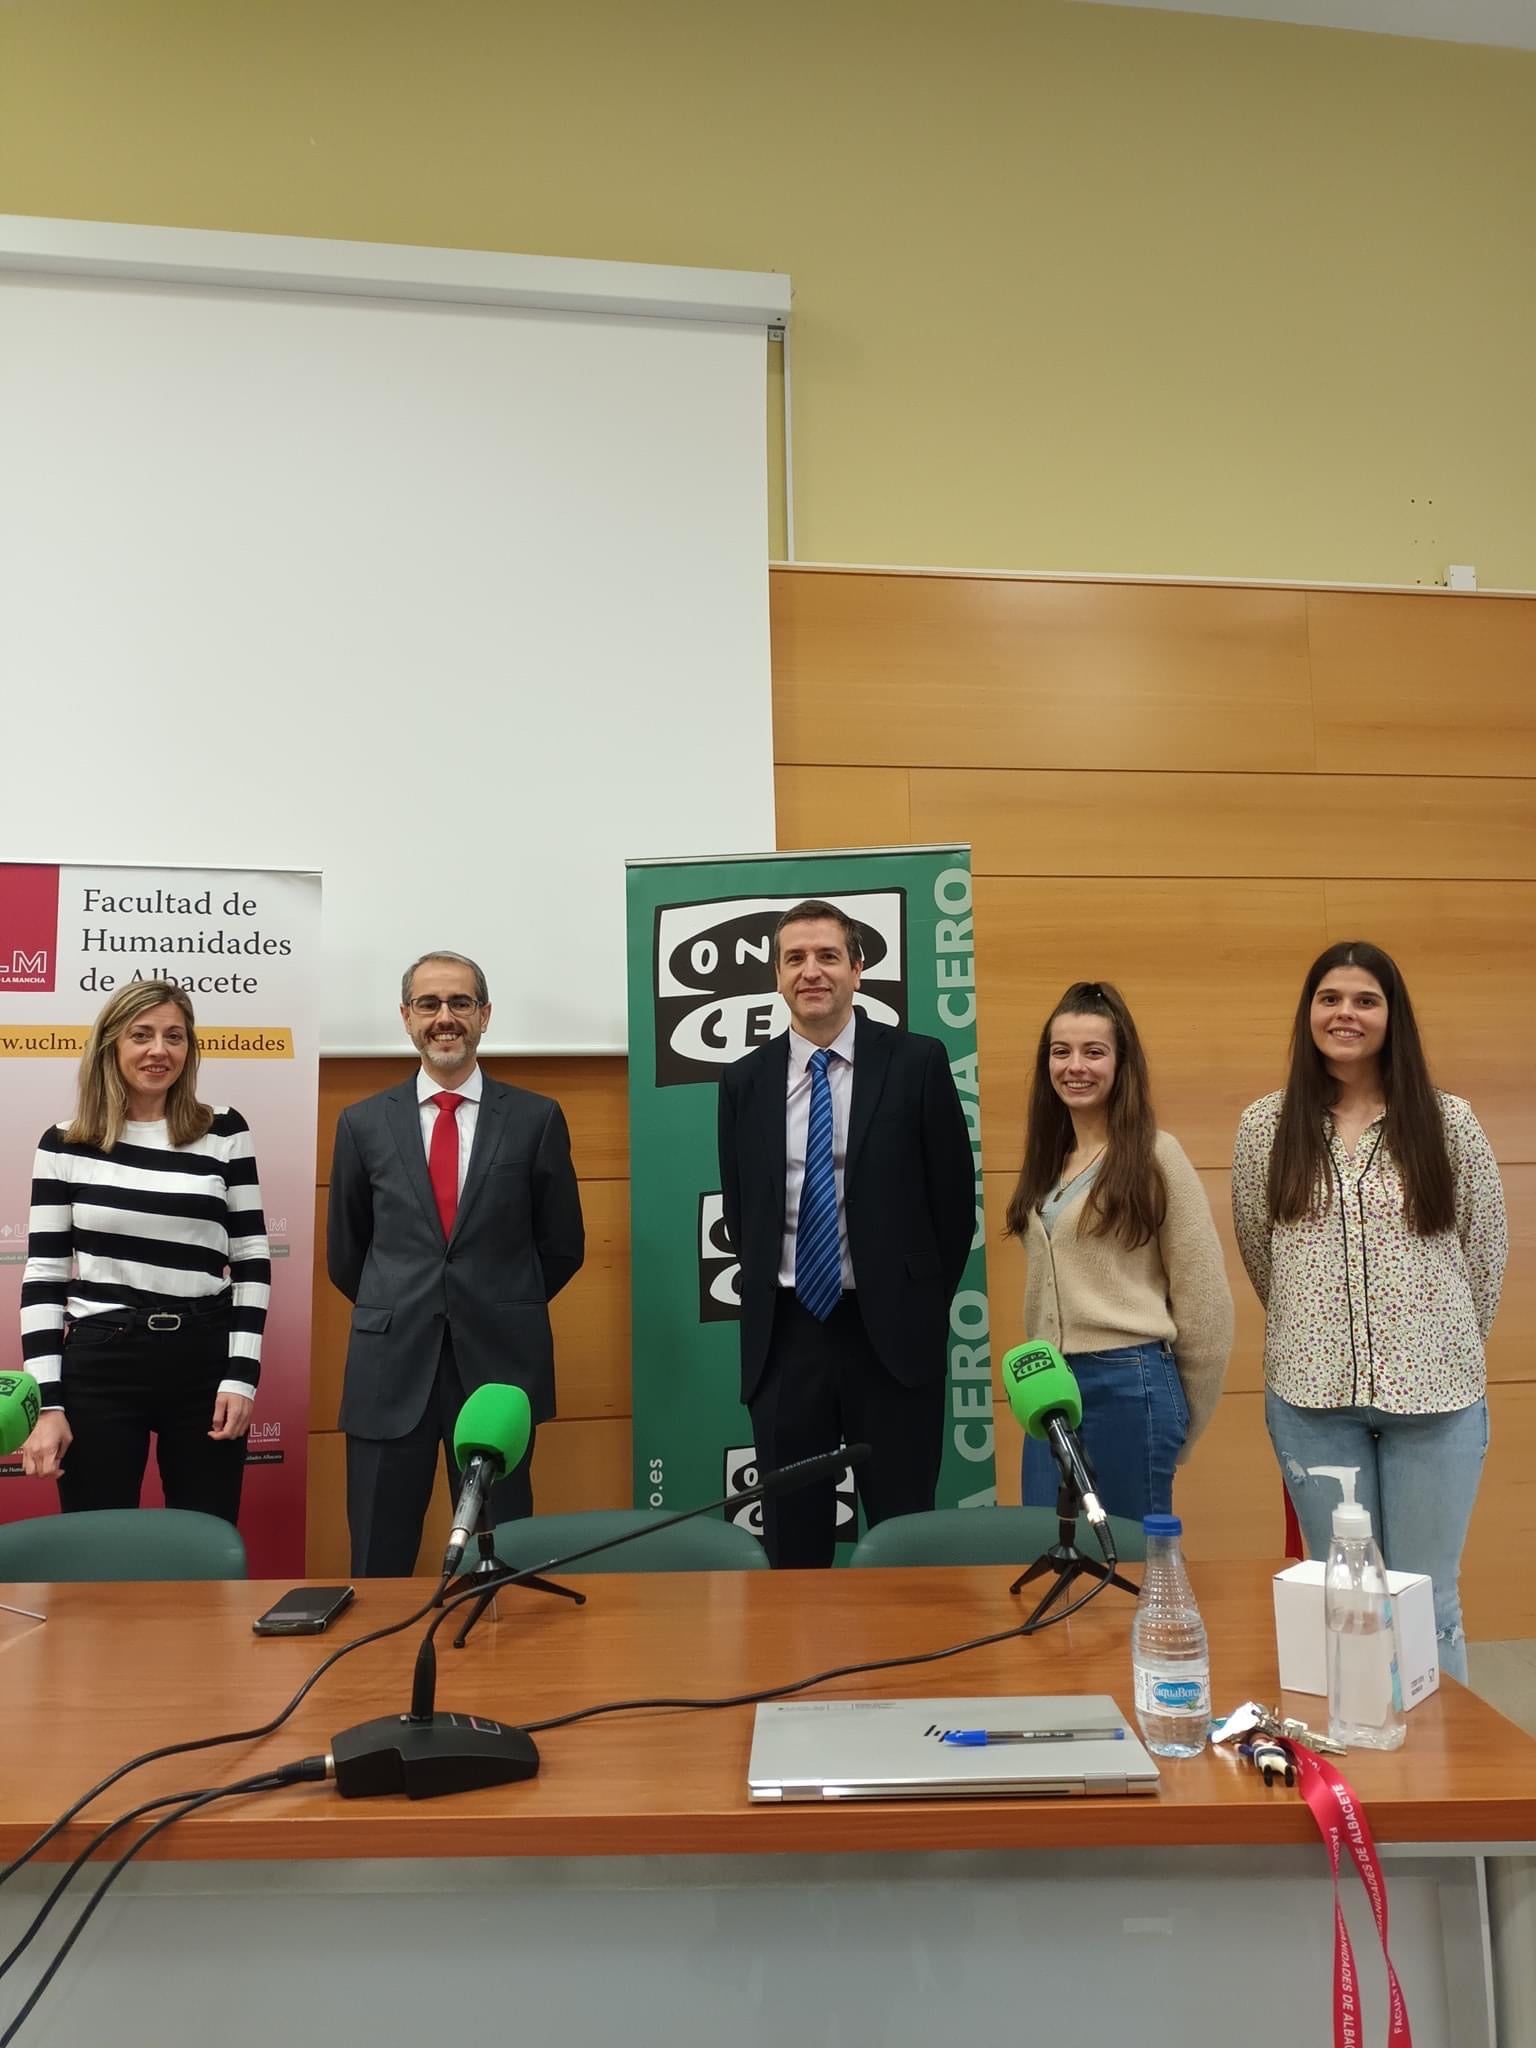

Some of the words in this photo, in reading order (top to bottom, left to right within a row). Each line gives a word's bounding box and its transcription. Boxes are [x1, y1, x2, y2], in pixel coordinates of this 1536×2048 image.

[82, 888, 213, 916] Facultad
[222, 892, 258, 916] de
[80, 928, 293, 956] Humanidades
[933, 867, 975, 1029] CERO
[79, 967, 115, 992] de
[0, 1032, 88, 1051] w.uclm.
[949, 1289, 995, 1463] CERO
[1020, 1360, 1048, 1375] CERO
[649, 1458, 663, 1510] o.es
[1331, 1783, 1365, 1845] ALBACETE
[1355, 1846, 1370, 1863] DE
[1342, 1993, 1354, 2012] DE
[1391, 1970, 1403, 2035] FACULT
